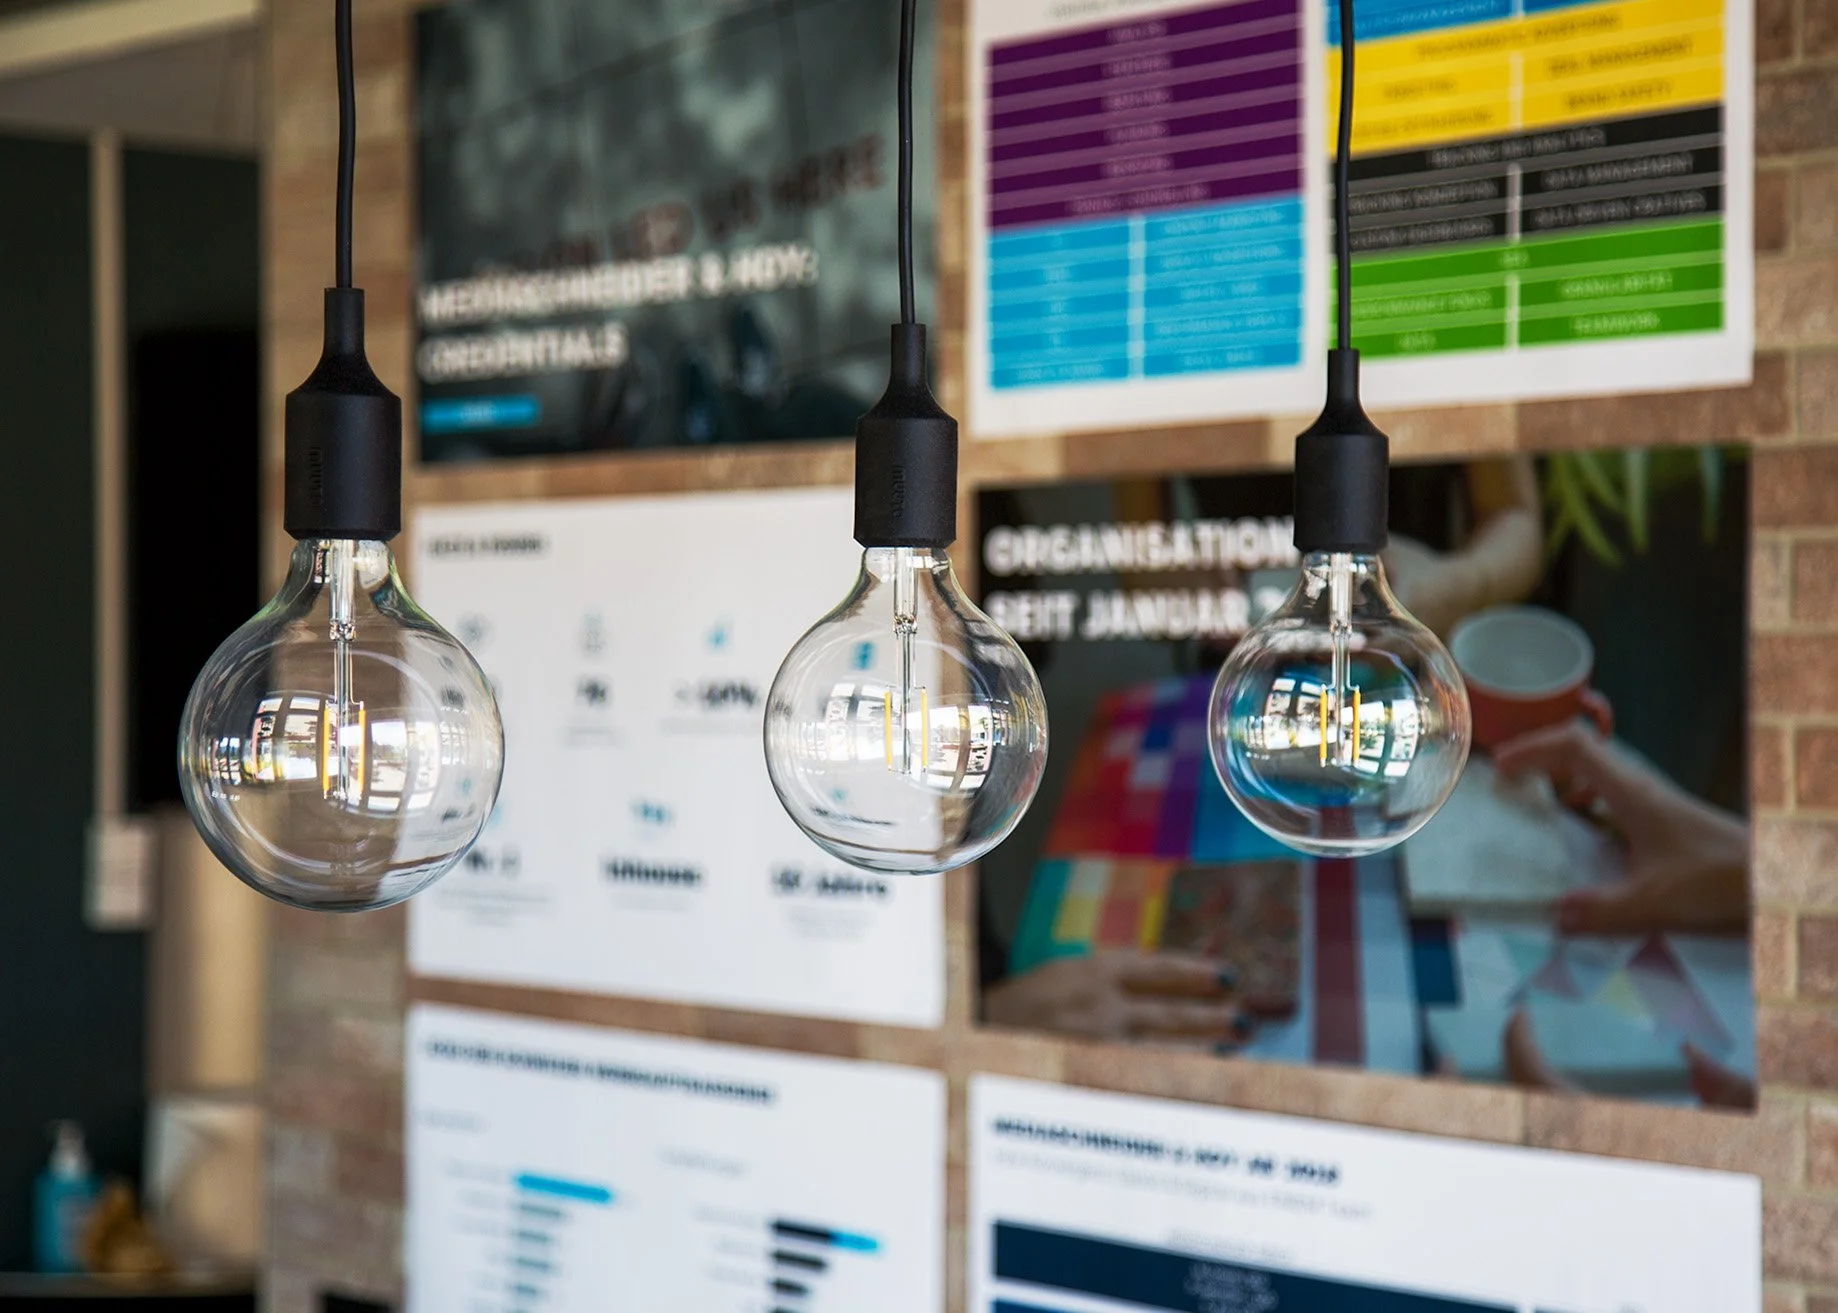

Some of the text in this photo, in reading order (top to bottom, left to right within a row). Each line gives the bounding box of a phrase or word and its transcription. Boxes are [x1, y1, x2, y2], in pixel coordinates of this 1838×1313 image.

[985, 515, 1298, 576] ORGANISATION
[986, 588, 1080, 641] SEIT
[1084, 588, 1249, 640] JANUAR
